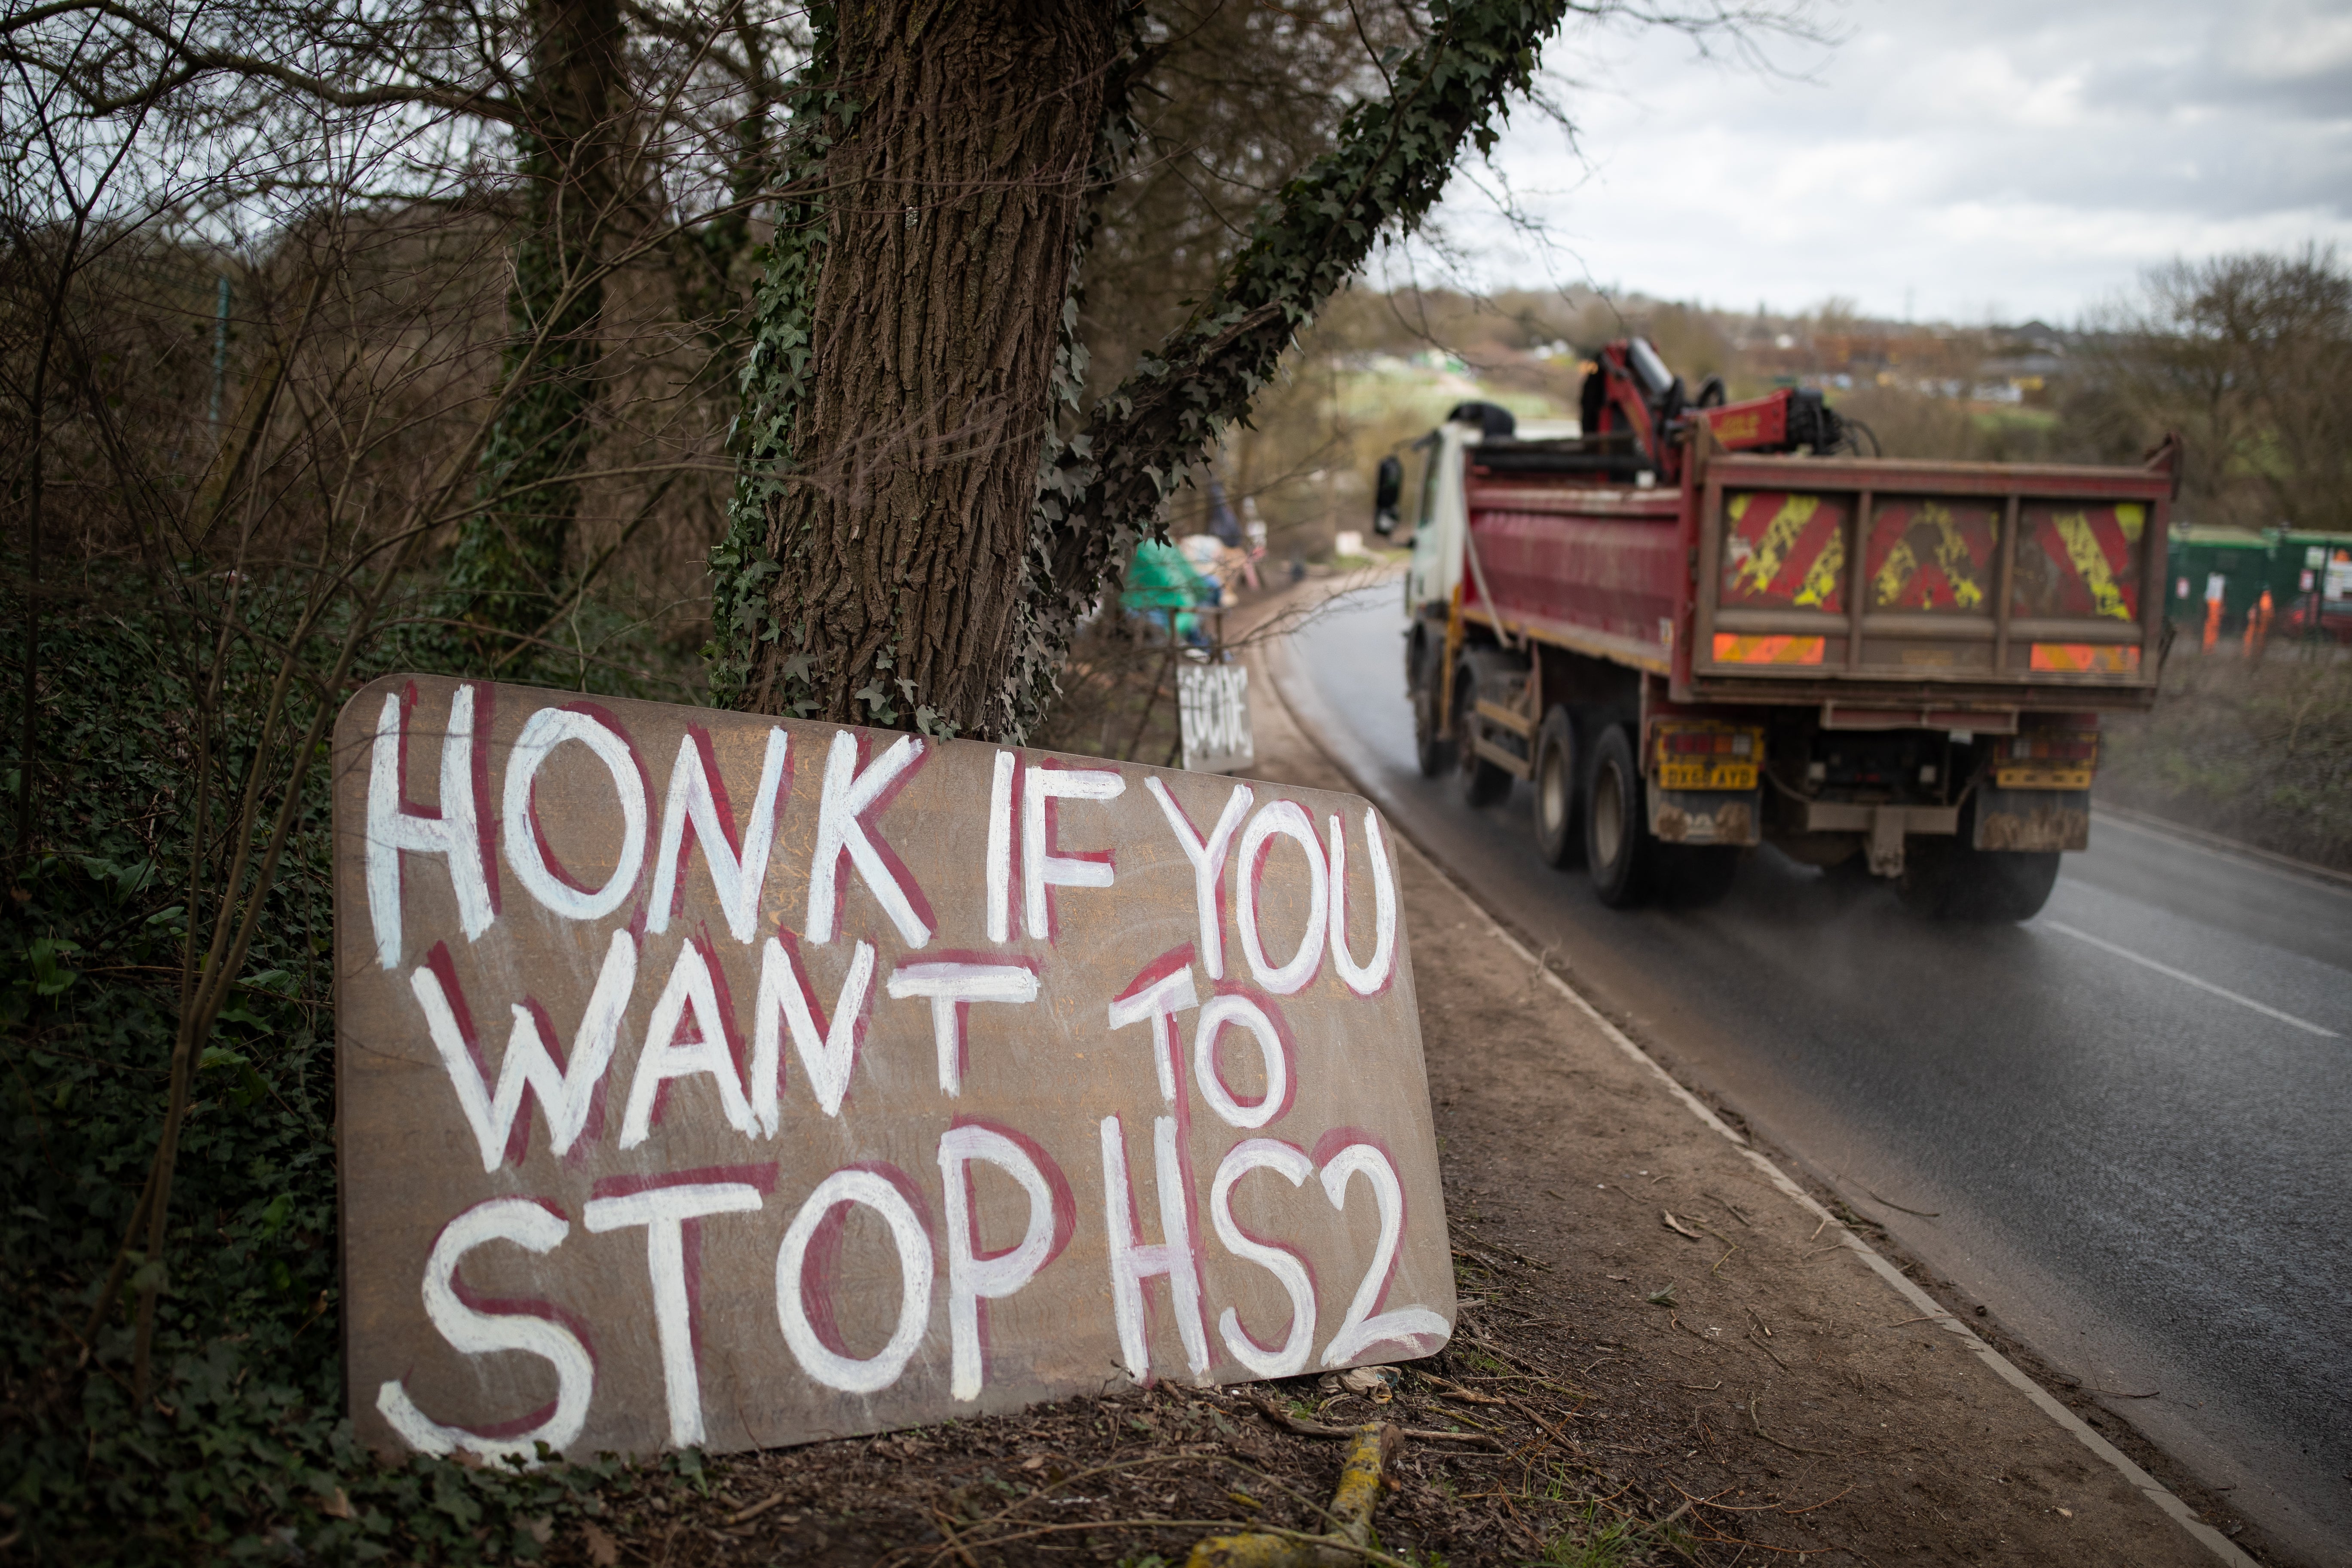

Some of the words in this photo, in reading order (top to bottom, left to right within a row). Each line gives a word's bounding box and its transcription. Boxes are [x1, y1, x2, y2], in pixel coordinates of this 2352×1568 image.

[365, 680, 937, 970] HONK
[986, 749, 1127, 944] IF
[1143, 775, 1399, 996] YOU
[411, 923, 1042, 1171] WANT
[1109, 943, 1295, 1135] TO
[376, 1115, 1075, 1467] STOP
[1100, 1112, 1451, 1387] HS2
